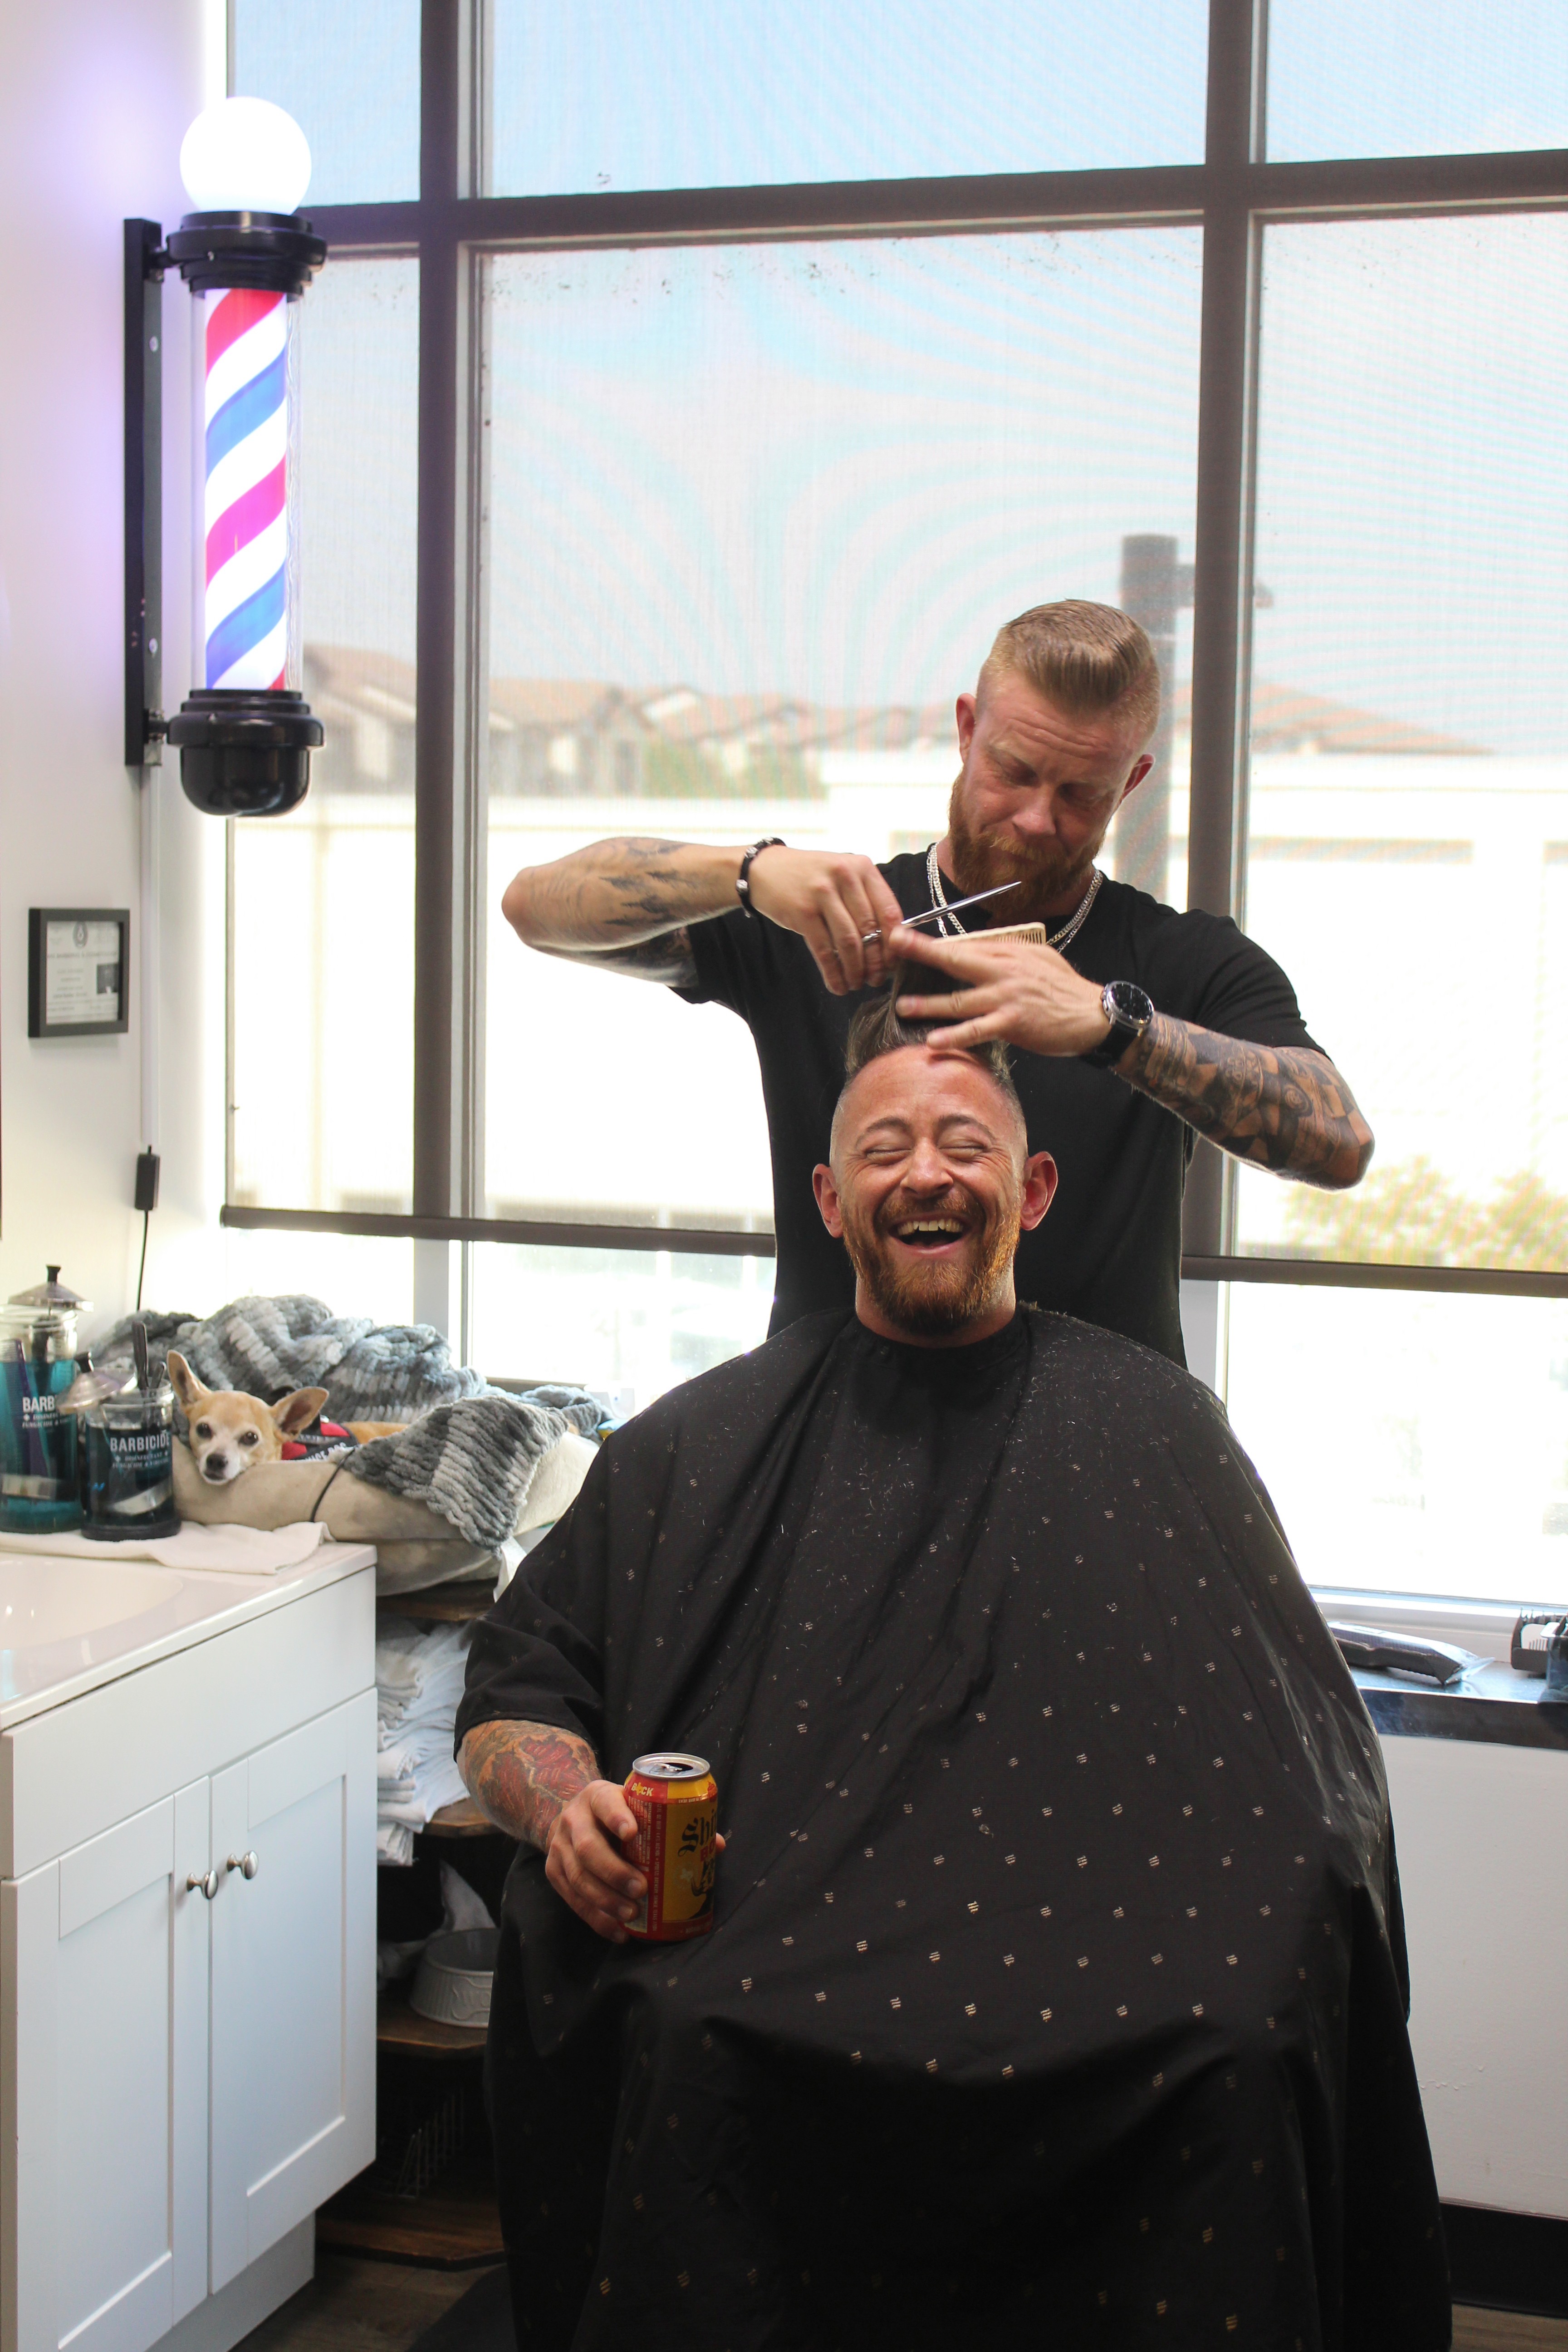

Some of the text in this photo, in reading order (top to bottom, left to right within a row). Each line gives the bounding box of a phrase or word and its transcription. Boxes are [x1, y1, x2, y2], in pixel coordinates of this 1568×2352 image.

[22, 1395, 56, 1412] BARB
[110, 1433, 169, 1452] BARBICIDE
[677, 1809, 716, 1857] Shi
